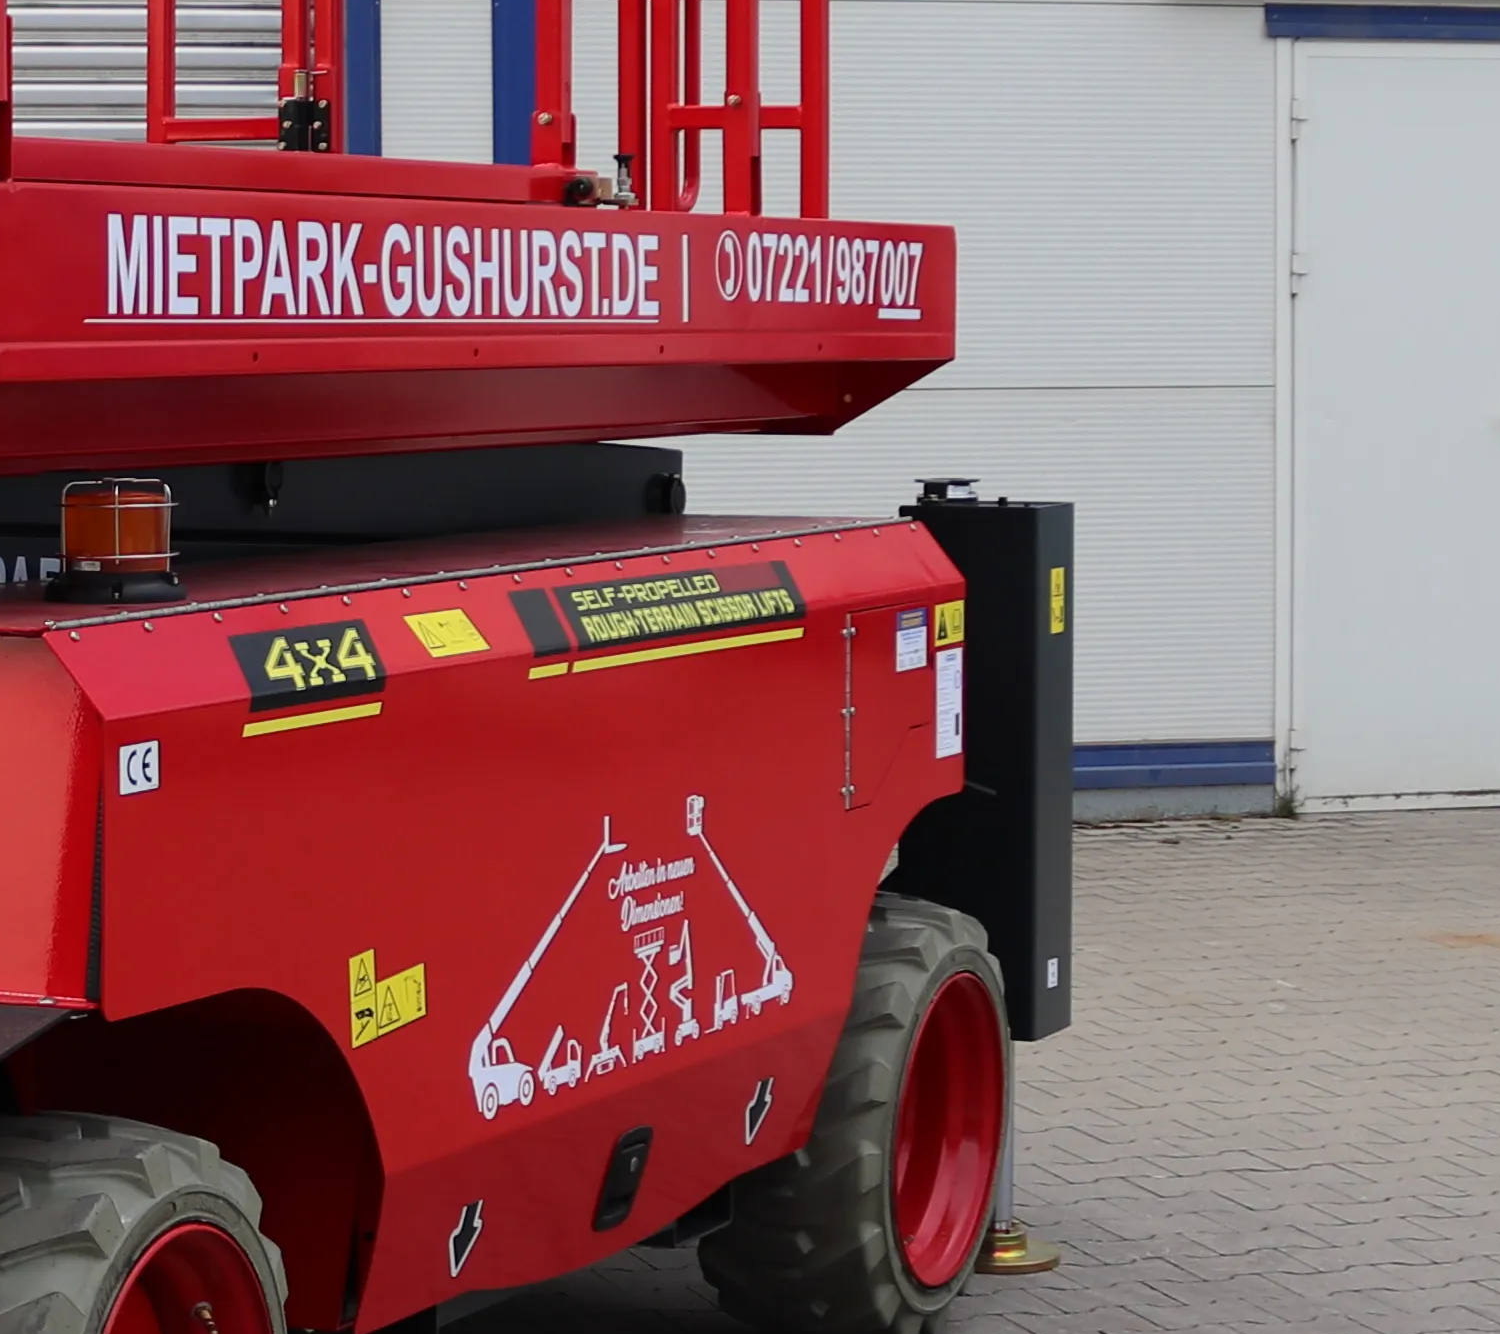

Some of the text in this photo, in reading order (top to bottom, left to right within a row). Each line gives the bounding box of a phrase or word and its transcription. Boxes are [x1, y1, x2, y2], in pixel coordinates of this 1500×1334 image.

[107, 213, 924, 316] MIETPARK-GUSHURST.DE 07221/987007
[570, 573, 721, 611] SELF-PROPELLED
[126, 746, 153, 786] CE
